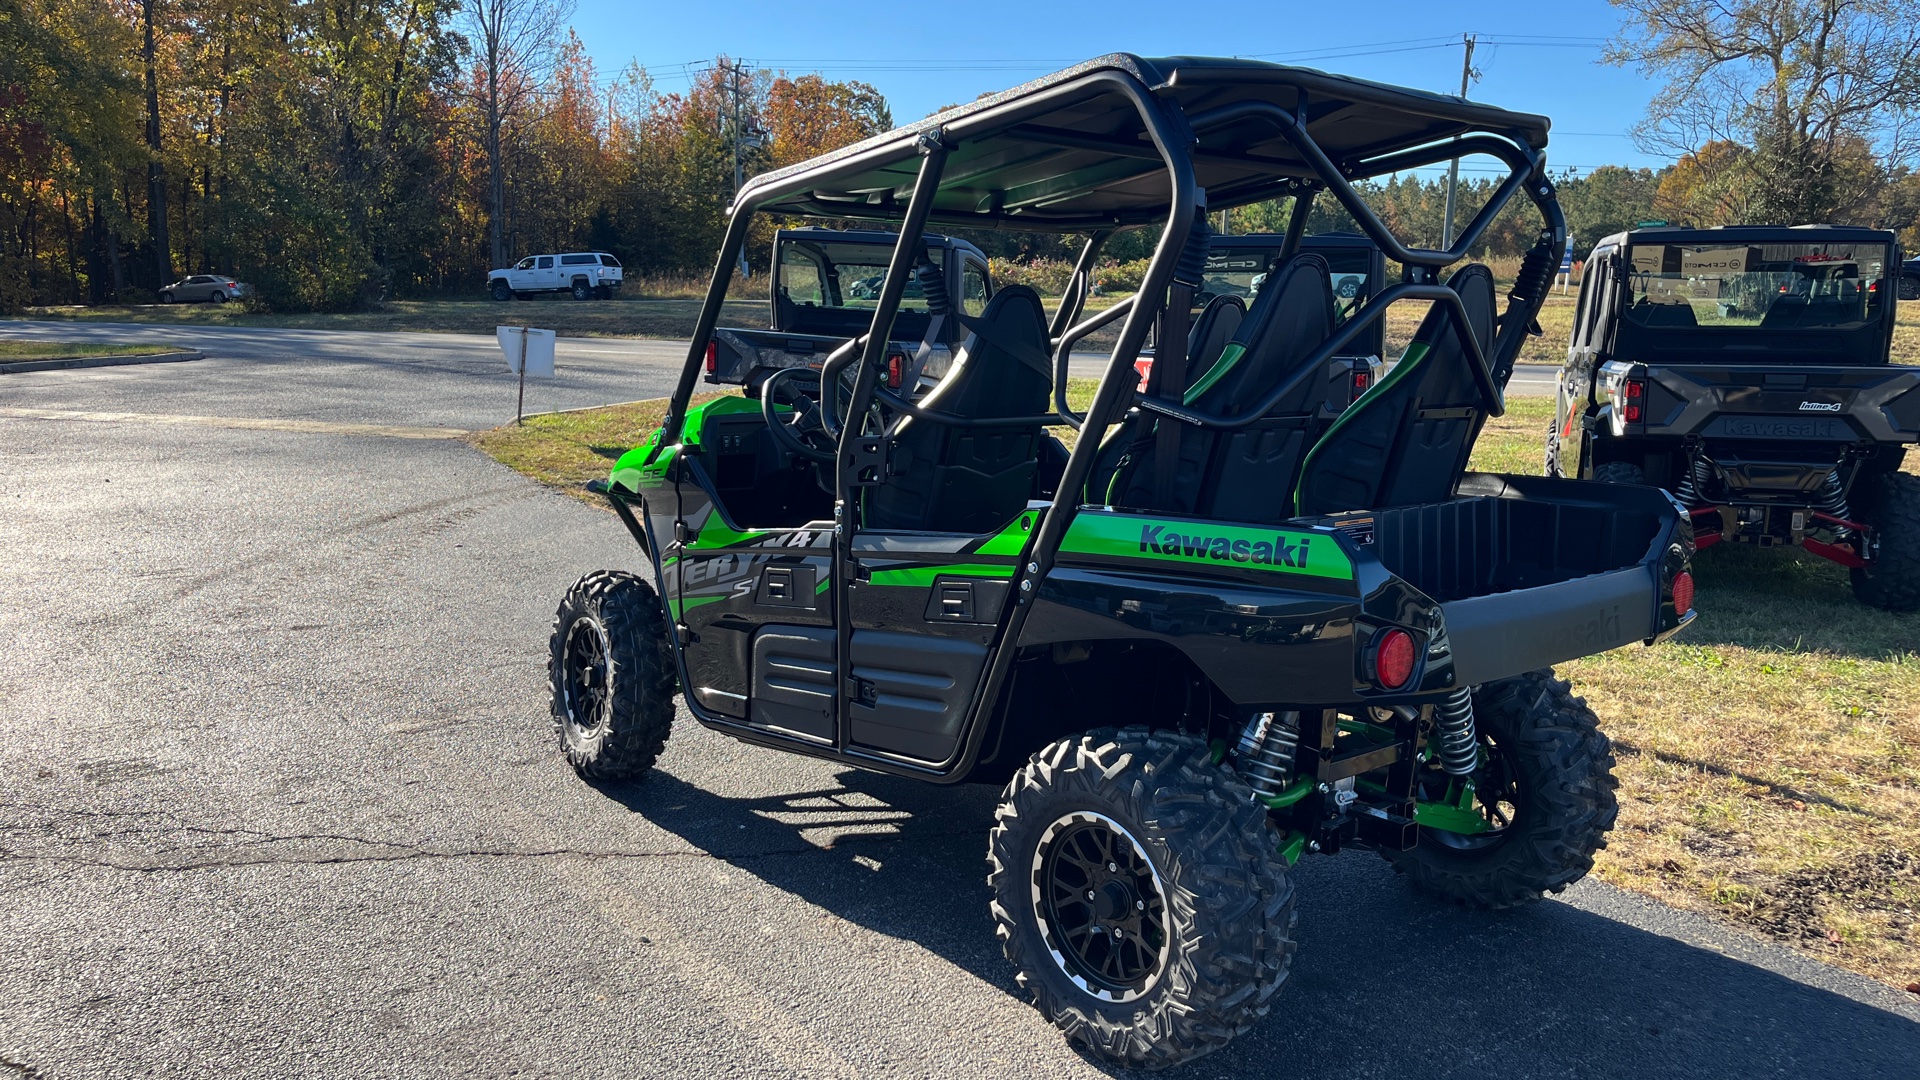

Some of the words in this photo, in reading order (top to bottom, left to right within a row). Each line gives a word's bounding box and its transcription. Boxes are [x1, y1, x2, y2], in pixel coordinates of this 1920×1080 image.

[1724, 418, 1835, 438] Kawasaki
[639, 468, 665, 480] SE
[1139, 524, 1311, 569] Kawasaki
